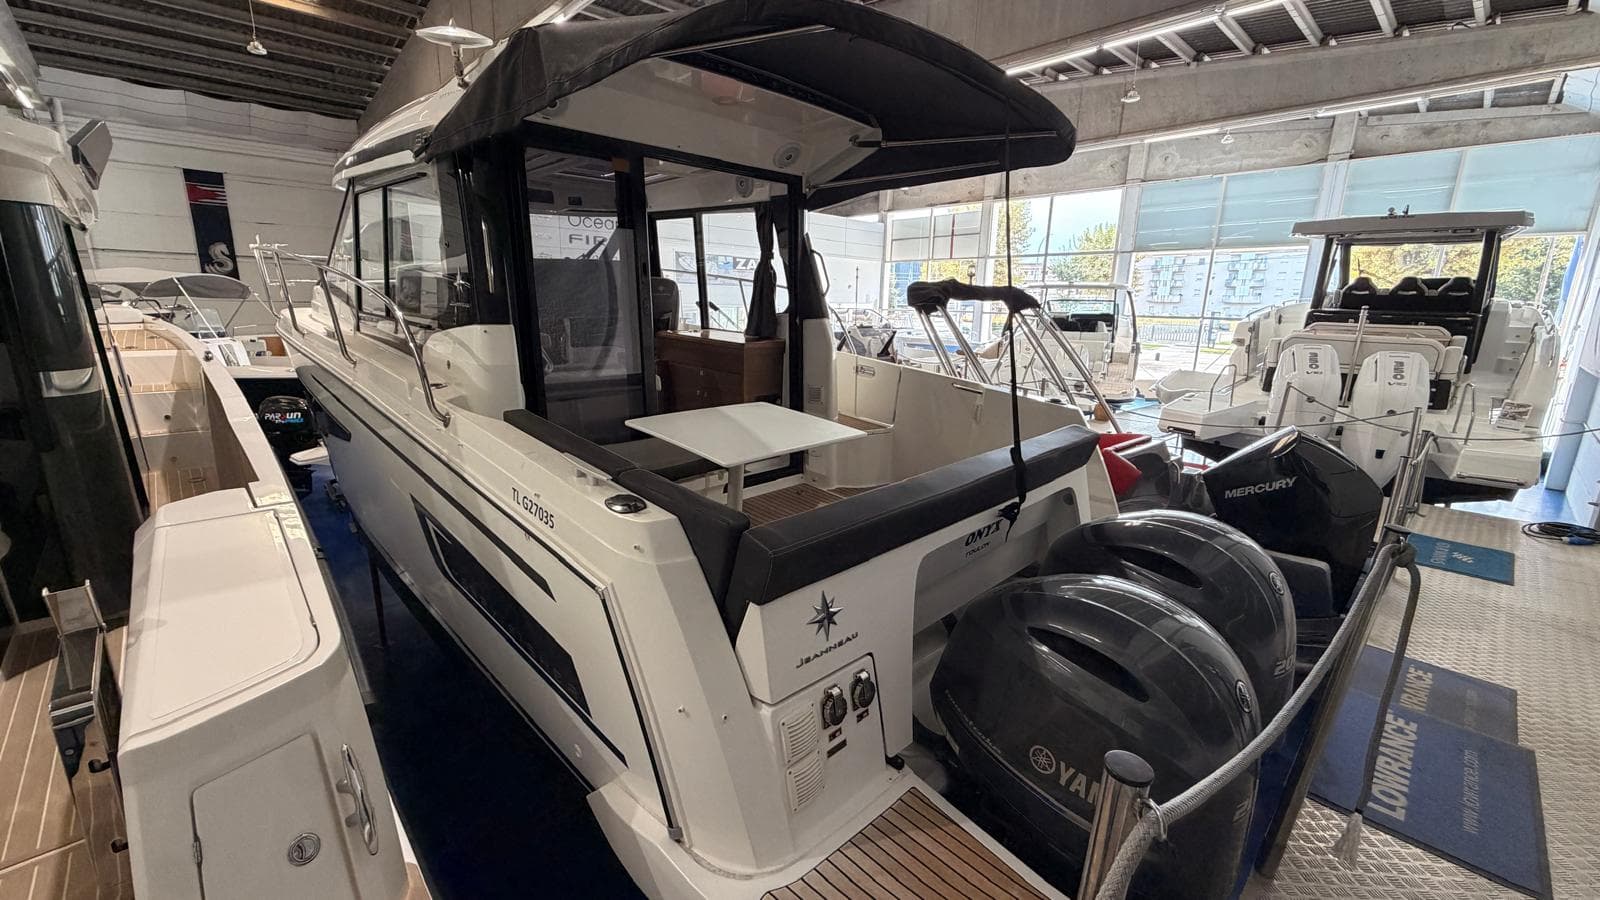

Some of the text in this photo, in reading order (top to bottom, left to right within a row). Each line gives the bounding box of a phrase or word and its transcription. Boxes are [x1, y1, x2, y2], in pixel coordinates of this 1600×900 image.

[568, 215, 617, 230] Ocea
[1224, 476, 1298, 499] MERCURY
[512, 487, 555, 529] TL G27035
[964, 518, 1004, 547] ONYX
[796, 631, 859, 669] JEANNEAU
[1366, 708, 1419, 823] LOWRANCE
